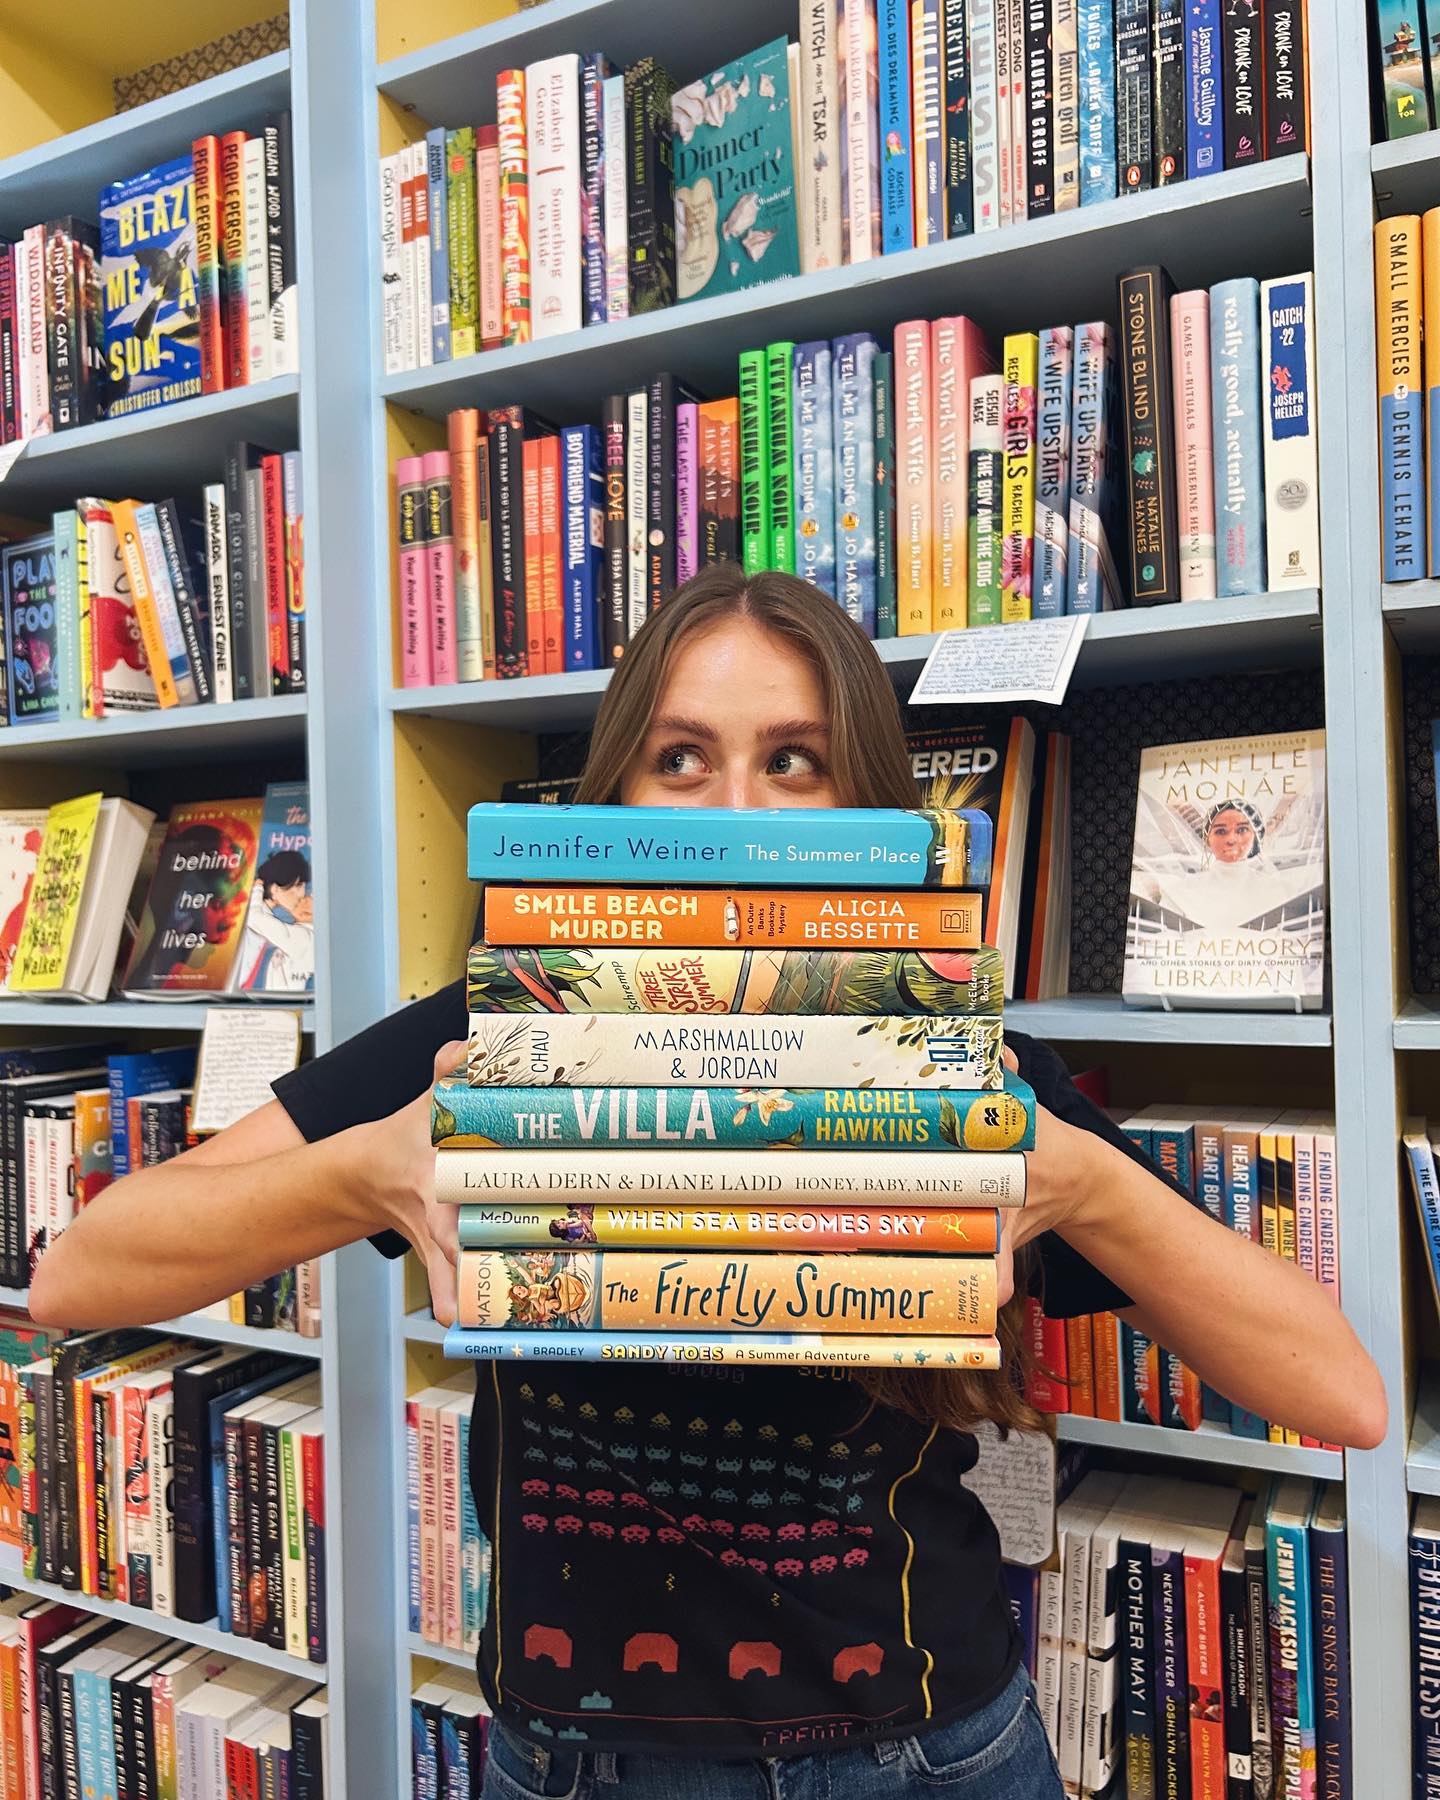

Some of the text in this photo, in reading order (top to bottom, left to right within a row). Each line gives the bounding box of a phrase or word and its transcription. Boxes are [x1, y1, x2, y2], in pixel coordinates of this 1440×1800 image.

[811, 4, 828, 143] WITCH TSAR
[1197, 26, 1216, 126] Jasmine Guillory
[1234, 27, 1253, 116] DRUNK on LOVE
[550, 71, 565, 155] Elizabeth
[1029, 50, 1047, 168] LAUREN GROFF
[1398, 109, 1416, 118] TOR
[677, 124, 782, 200] Dinner Party
[107, 262, 196, 312] ME A
[1183, 315, 1192, 358] GAMES
[1221, 296, 1244, 358] really
[1272, 306, 1303, 327] CATCH
[1279, 328, 1295, 347] -22
[56, 322, 68, 368] GATE
[110, 332, 161, 382] SUN
[1129, 292, 1148, 420] STONE BLIND
[973, 397, 984, 425] HASE
[986, 390, 999, 426] SEISHU
[1042, 339, 1062, 497] THE WIFE UPSTAIRS
[1186, 378, 1195, 430] RITUALS
[1221, 366, 1244, 423] good,
[1272, 392, 1304, 408] JOSEPH
[1274, 405, 1304, 420] HELLER
[1390, 232, 1413, 566] SMALL MERCIES DENNIS LEHANE
[770, 352, 788, 531] TITANIUM NOIR
[800, 362, 816, 513] TELL ME AN ENDING
[606, 422, 624, 522] FREE LOVE
[1004, 357, 1028, 579] RECKLESS GIRLS RACHEL HAWKINS
[1188, 444, 1198, 513] KATHERINE
[1224, 430, 1248, 515] actually
[566, 432, 585, 570] BOYFRIEND MATERIAL
[976, 453, 994, 588] THE BOY AND THE DOG
[1147, 497, 1160, 553] NATALIE
[209, 502, 222, 564] ARMADA
[1135, 499, 1146, 554] HAYNES
[908, 746, 998, 779] ERED
[1158, 748, 1308, 781] JANELLE
[1215, 743, 1243, 752] TIMES
[1248, 738, 1308, 749] BESTSELLER
[1166, 771, 1297, 804] MONÁE
[172, 850, 243, 872] behind
[493, 836, 921, 864] Jennifer Weiner The Summer Place
[179, 891, 214, 910] her
[514, 894, 698, 917] SMILE BEACH
[768, 901, 776, 937] Bookshop
[778, 904, 786, 934] Mystery
[820, 900, 906, 917] ALICIA
[162, 929, 208, 950] lives
[549, 920, 664, 940] MURDER
[747, 924, 754, 936] An
[804, 922, 920, 940] BESSETTE
[1141, 938, 1315, 957] THE MEMORY
[612, 961, 641, 1011] Schrempp
[640, 970, 668, 1008] THREE
[656, 962, 699, 1013] STRIKE
[680, 955, 729, 1012] SUMMER
[968, 963, 980, 1011] McElderry
[980, 974, 990, 1001] Books
[1154, 969, 1295, 988] LIBRARIAN
[530, 1030, 549, 1073] CHAU
[634, 1028, 805, 1053] MARSHMALLOW
[670, 1056, 780, 1080] & JORDAN
[110, 1069, 125, 1135] UPGRADE
[514, 1090, 718, 1142] THE VILLA
[824, 1090, 922, 1115] RACHEL
[816, 1116, 930, 1142] HAWKINS
[463, 1172, 964, 1194] LAURA DERN & DIANE LADD HONEY, BABY, MINE
[1232, 1144, 1249, 1191] HEART
[480, 1210, 540, 1227] McDunn
[608, 1210, 926, 1236] WHEN SEA BECOMES SKY
[1318, 1150, 1336, 1285] FINDING CINDERELLA
[476, 1254, 493, 1328] MATSON
[606, 1259, 934, 1328] The Firefly Summer
[958, 1278, 969, 1323] SIMON &
[968, 1273, 980, 1324] SCHUSTER
[464, 1344, 871, 1362] GRANT BRADLEY SANDY TOES A Summer Adventure
[266, 1432, 278, 1540] JENNIFER EGAN
[422, 1419, 436, 1528] IT ENDS WITH US
[1126, 1558, 1144, 1651] MOTHER
[1276, 1537, 1298, 1671] JENNY JACKSON
[1130, 1657, 1146, 1706] MAY
